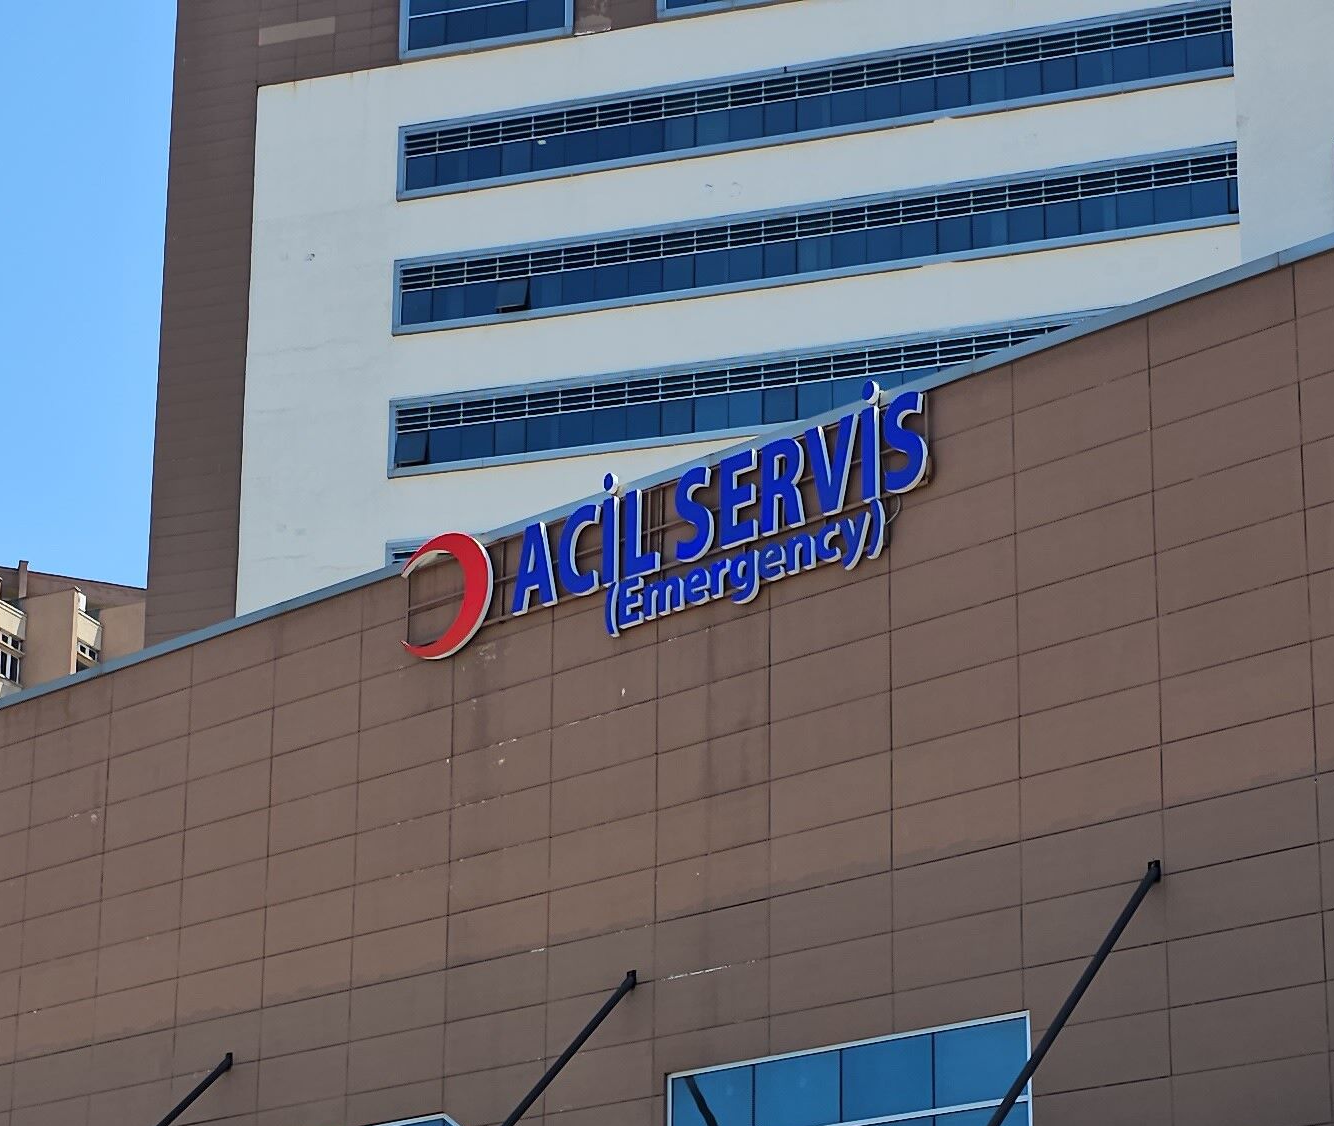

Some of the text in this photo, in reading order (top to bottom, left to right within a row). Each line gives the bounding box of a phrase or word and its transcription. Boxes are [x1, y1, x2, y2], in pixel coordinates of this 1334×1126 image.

[511, 379, 928, 617] ACİL SERVİS
[604, 498, 886, 638] (Emergency)
